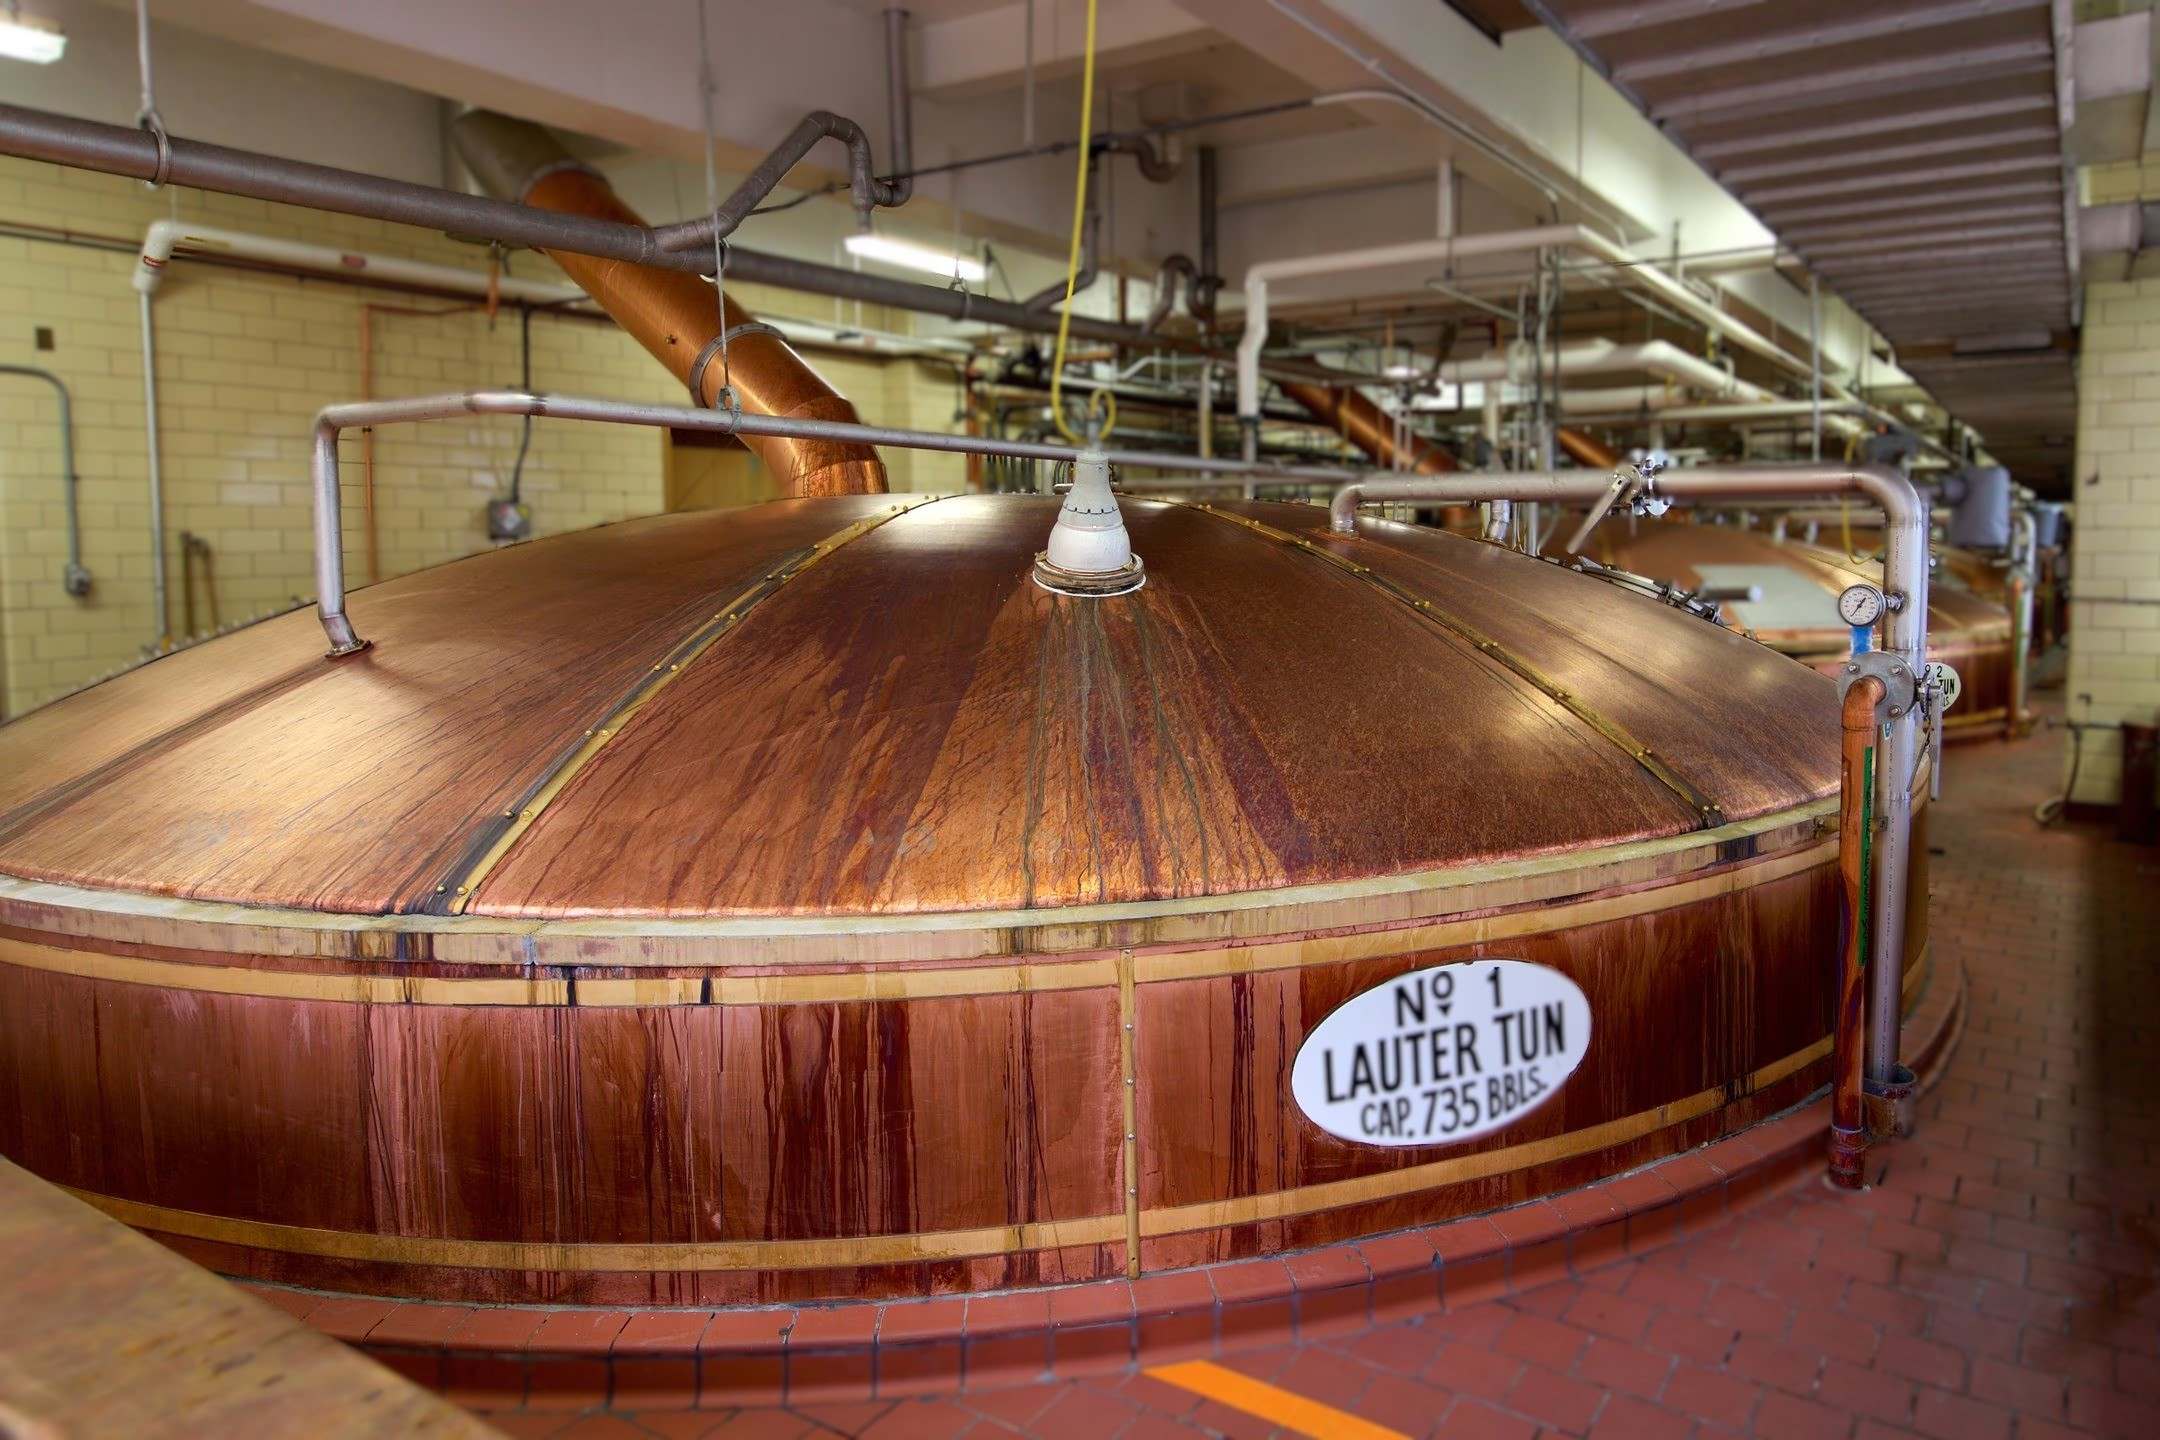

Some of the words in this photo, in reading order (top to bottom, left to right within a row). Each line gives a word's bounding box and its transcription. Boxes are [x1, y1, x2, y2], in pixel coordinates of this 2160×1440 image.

[1936, 665, 1943, 678] 2
[1939, 679, 1955, 695] TUN
[1486, 966, 1503, 1008] 1
[1323, 1021, 1483, 1105] LAUTER
[1493, 1000, 1567, 1067] TUN
[1360, 1097, 1414, 1139] CAP.
[1422, 1081, 1482, 1136] 735
[1487, 1066, 1548, 1121] BBLS.
